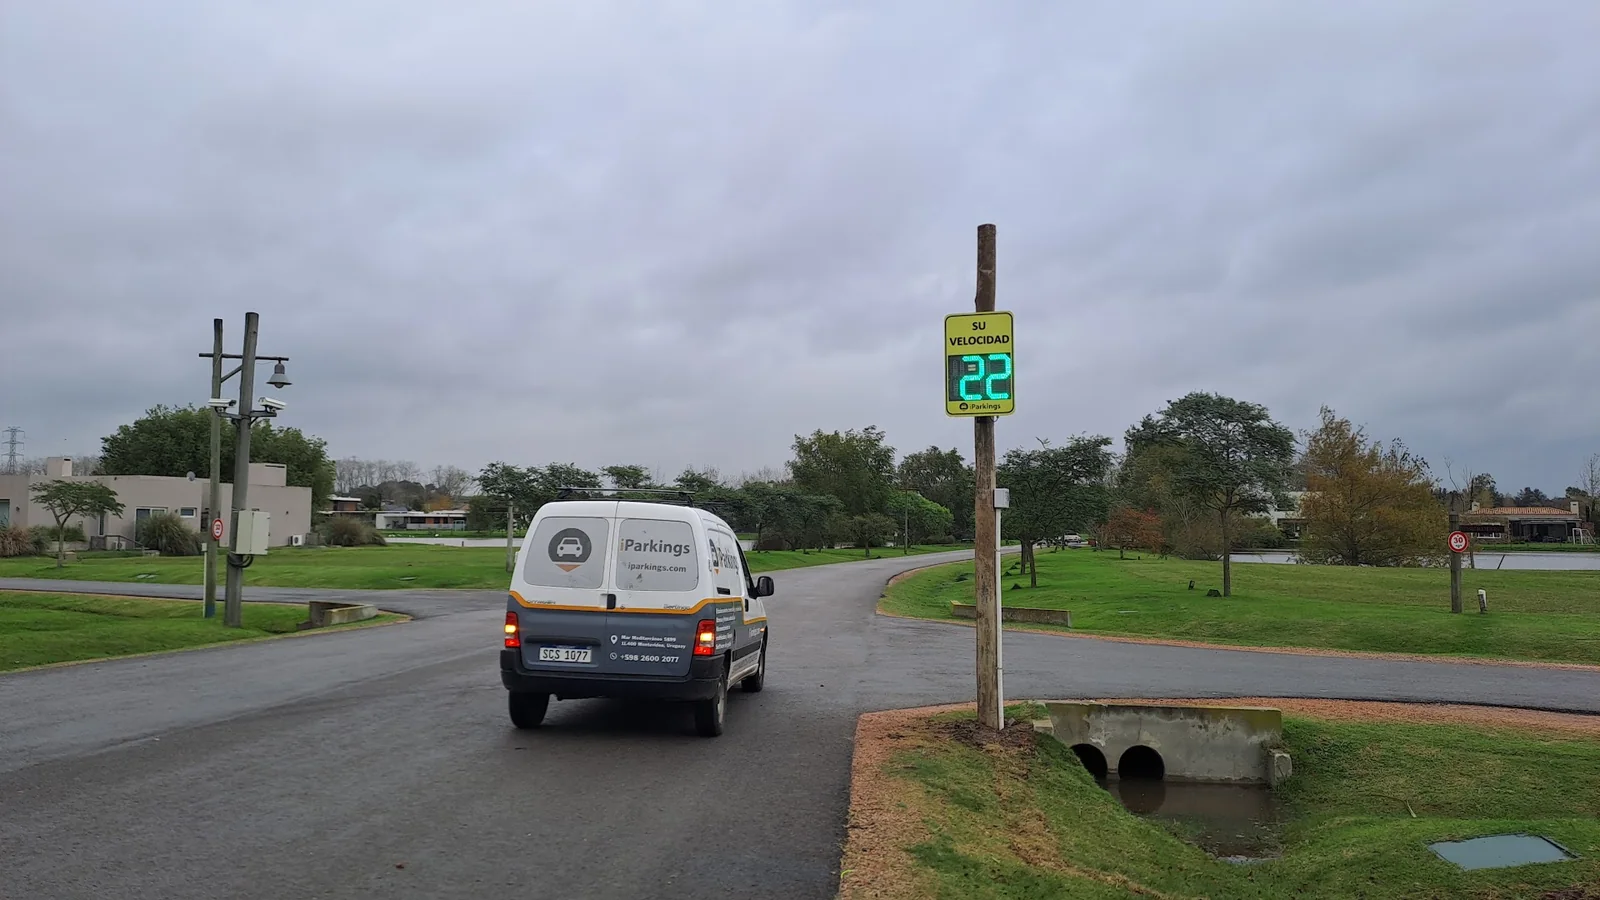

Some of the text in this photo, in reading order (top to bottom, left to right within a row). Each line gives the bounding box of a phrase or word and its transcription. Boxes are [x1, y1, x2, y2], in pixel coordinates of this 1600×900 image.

[972, 321, 986, 331] SU
[949, 335, 1010, 346] VELOCIDAD
[960, 353, 1011, 400] 22
[969, 402, 1001, 411] iParkings
[620, 538, 690, 557] iParkings
[628, 562, 687, 573] iparkings.com
[542, 649, 588, 662] SCS 1077
[620, 653, 639, 661] +598
[661, 655, 680, 663] 2077
